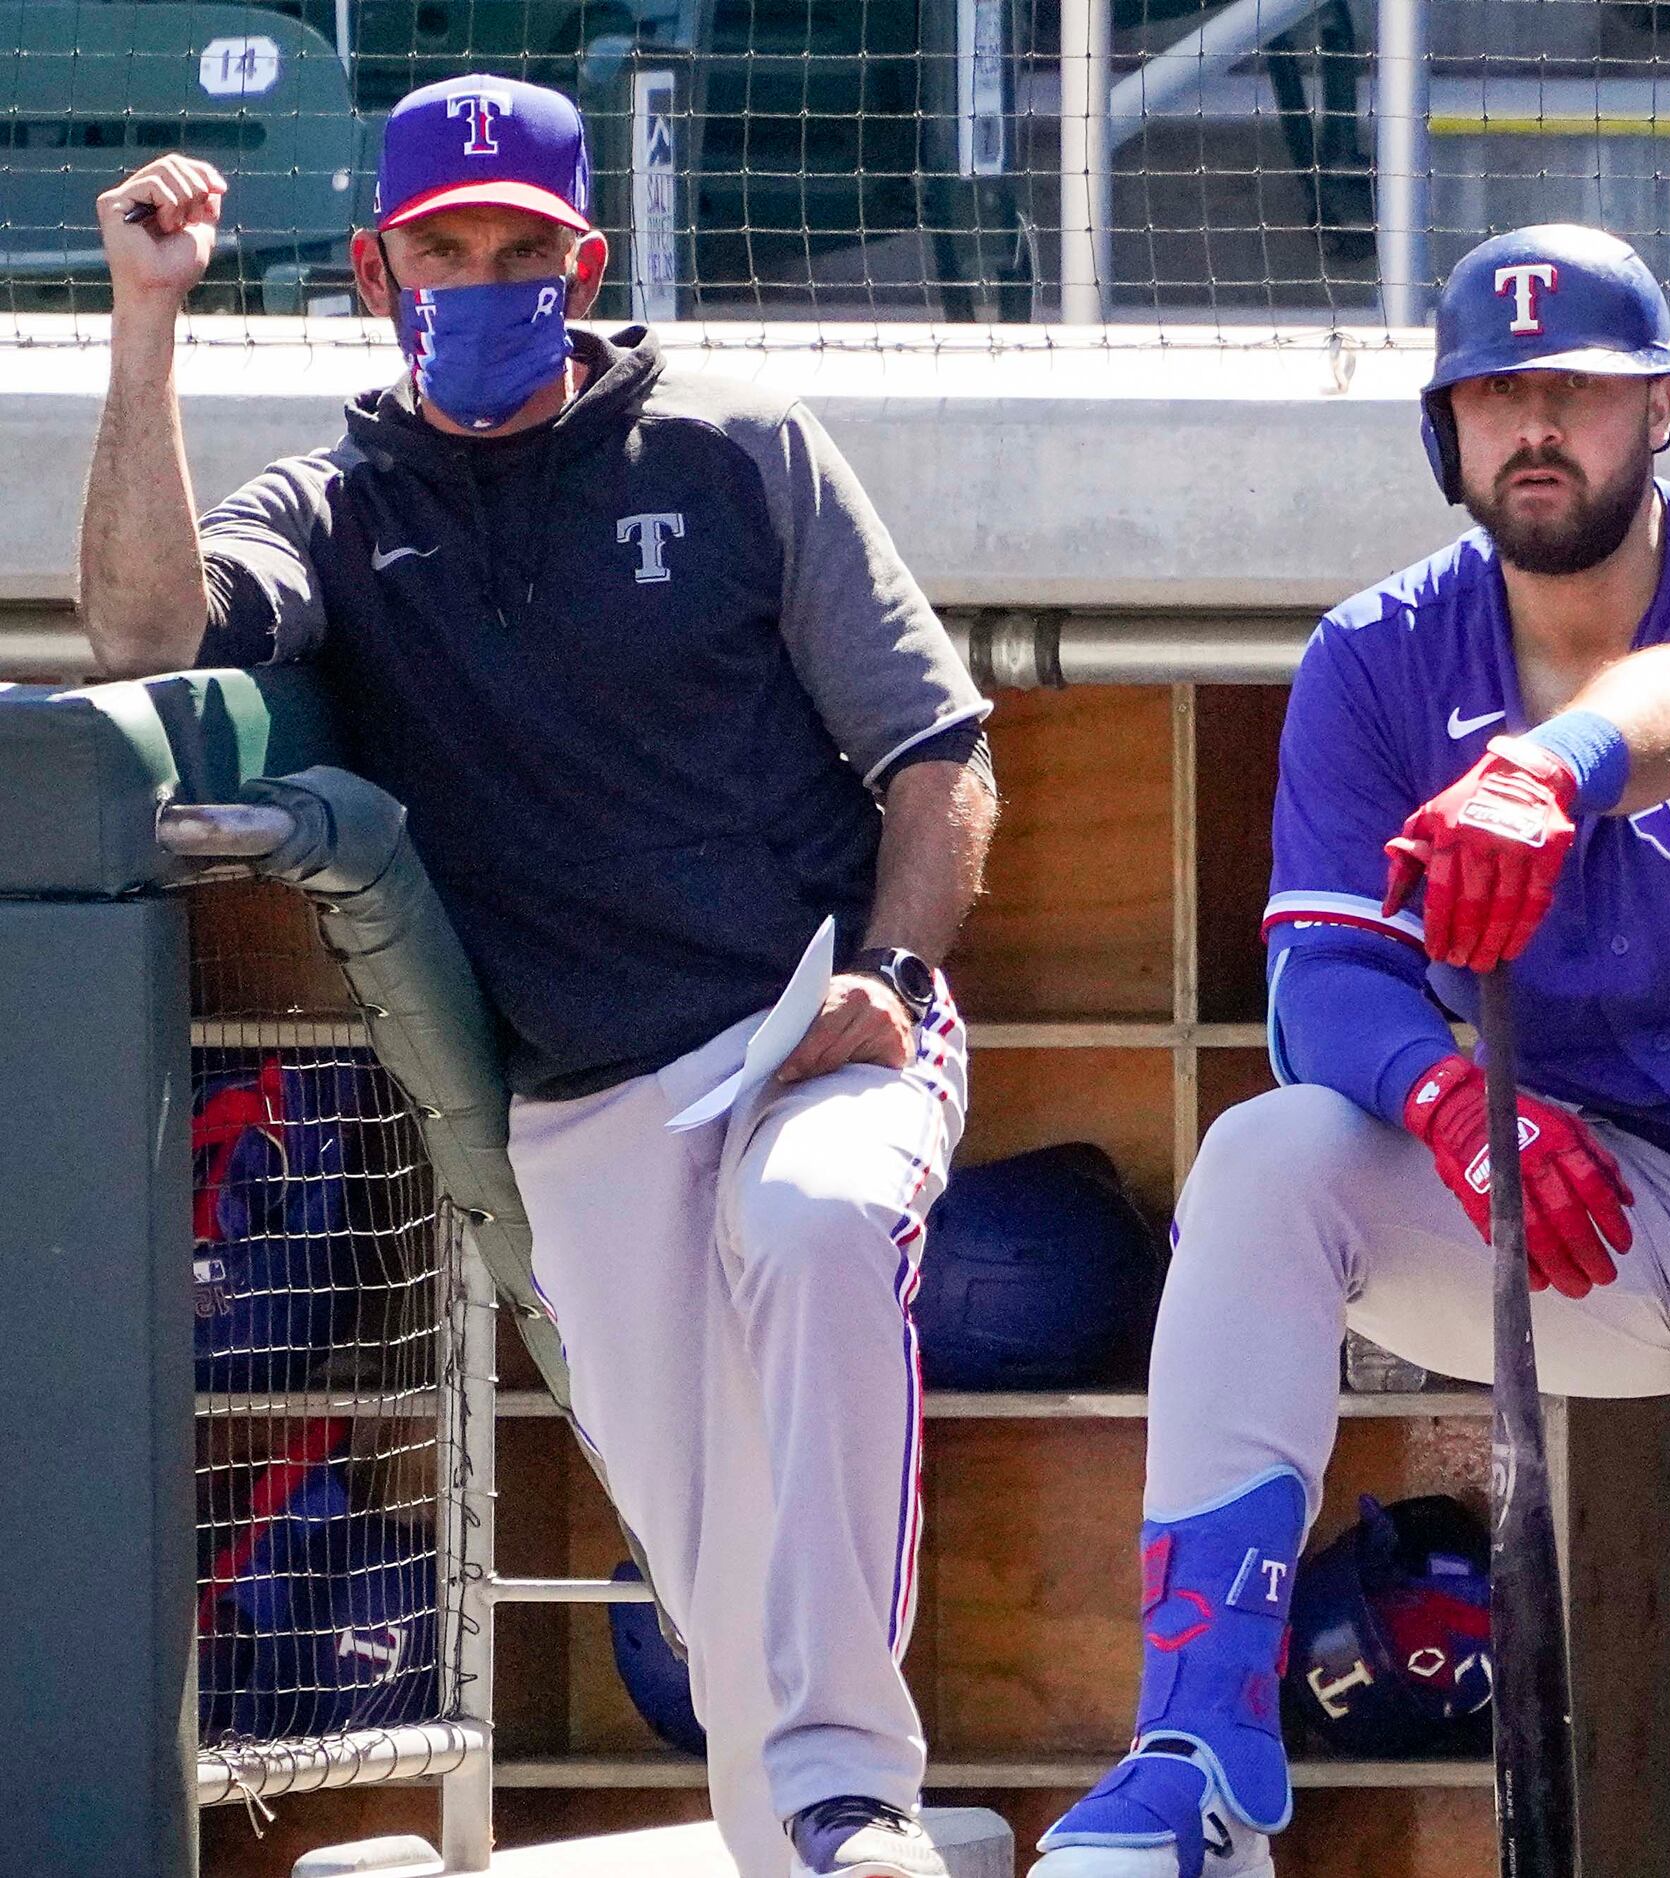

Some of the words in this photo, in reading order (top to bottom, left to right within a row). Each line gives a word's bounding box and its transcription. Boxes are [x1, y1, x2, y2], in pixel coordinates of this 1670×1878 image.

[221, 47, 257, 81] 14
[447, 90, 513, 156] T
[1494, 264, 1558, 336] T
[616, 513, 685, 583] T
[1261, 1559, 1288, 1602] T
[1307, 1658, 1375, 1720] T
